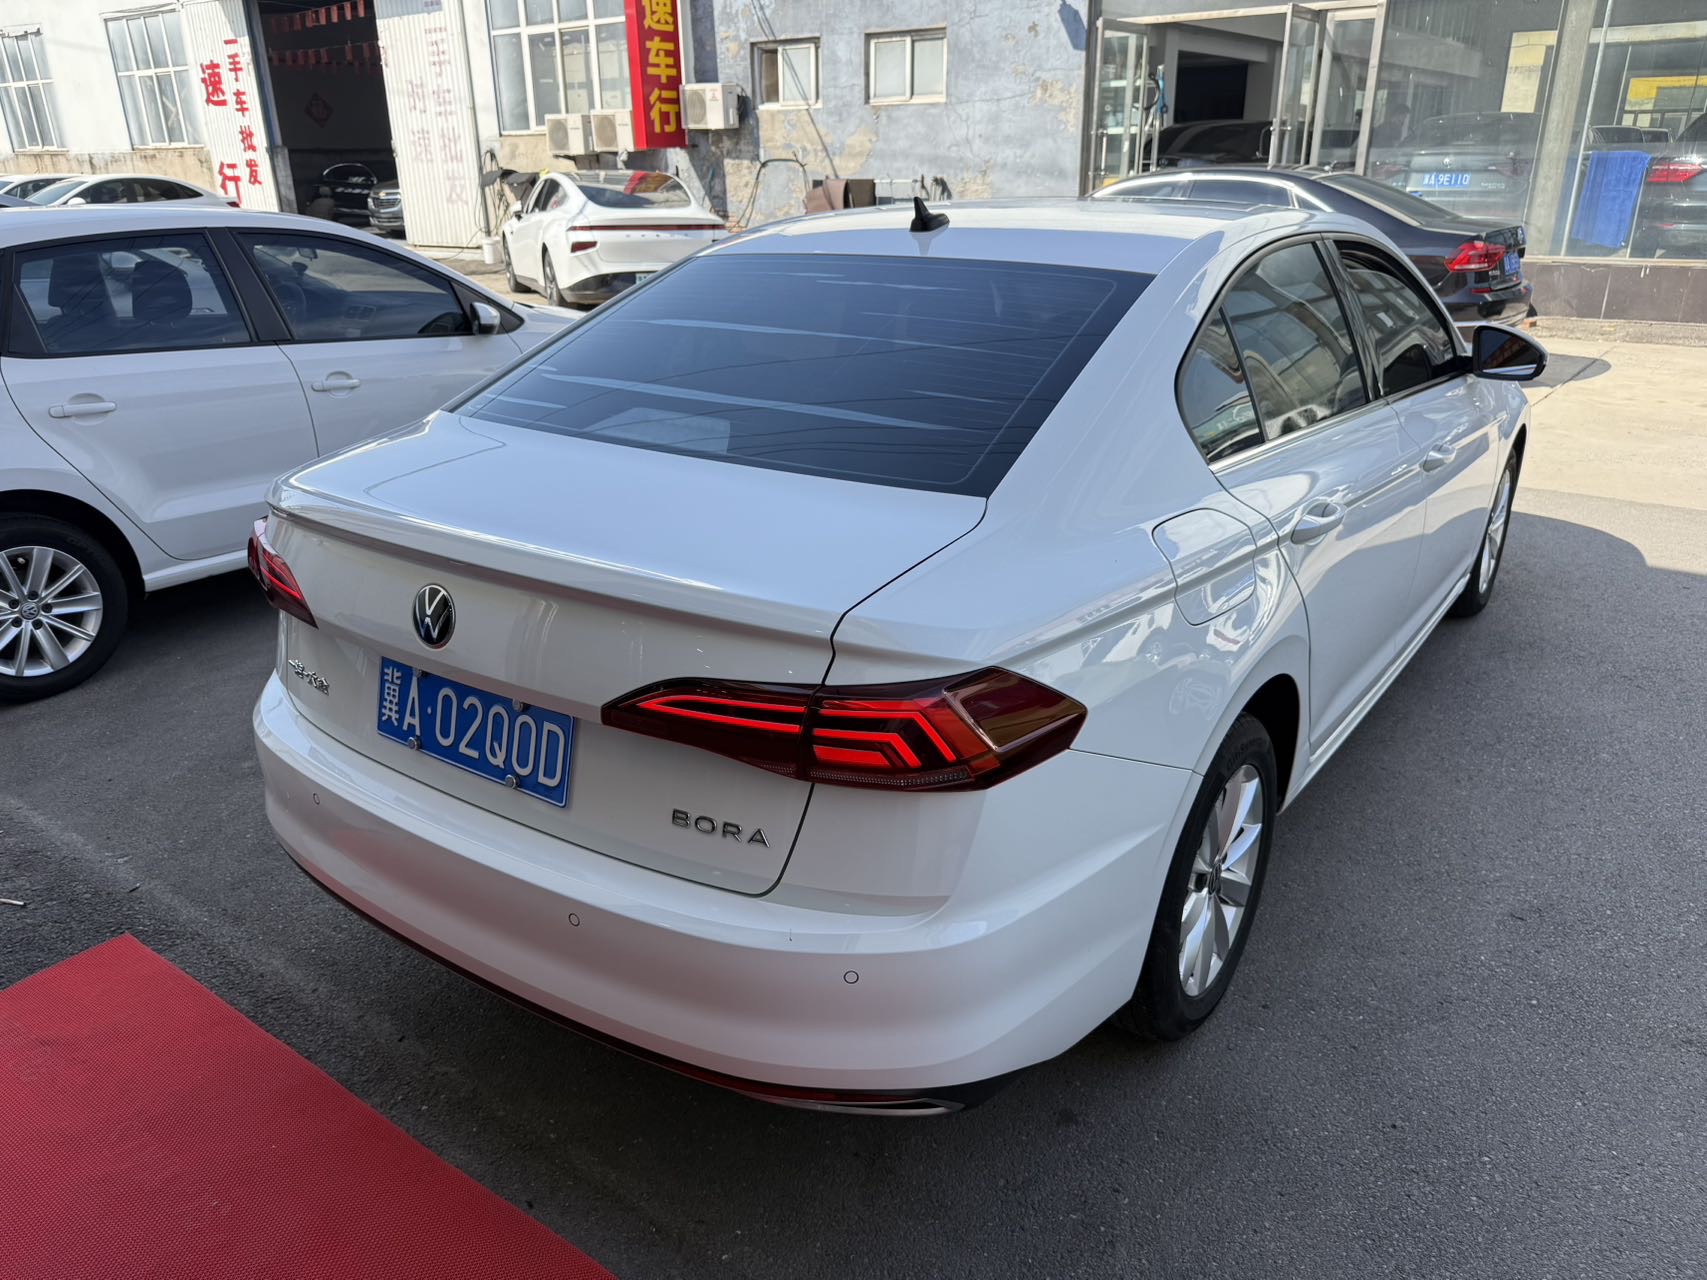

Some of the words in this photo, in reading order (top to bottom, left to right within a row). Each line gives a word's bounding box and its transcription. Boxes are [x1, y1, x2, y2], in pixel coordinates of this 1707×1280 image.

[642, 0, 679, 133] 速车行
[671, 808, 770, 848] BORA
